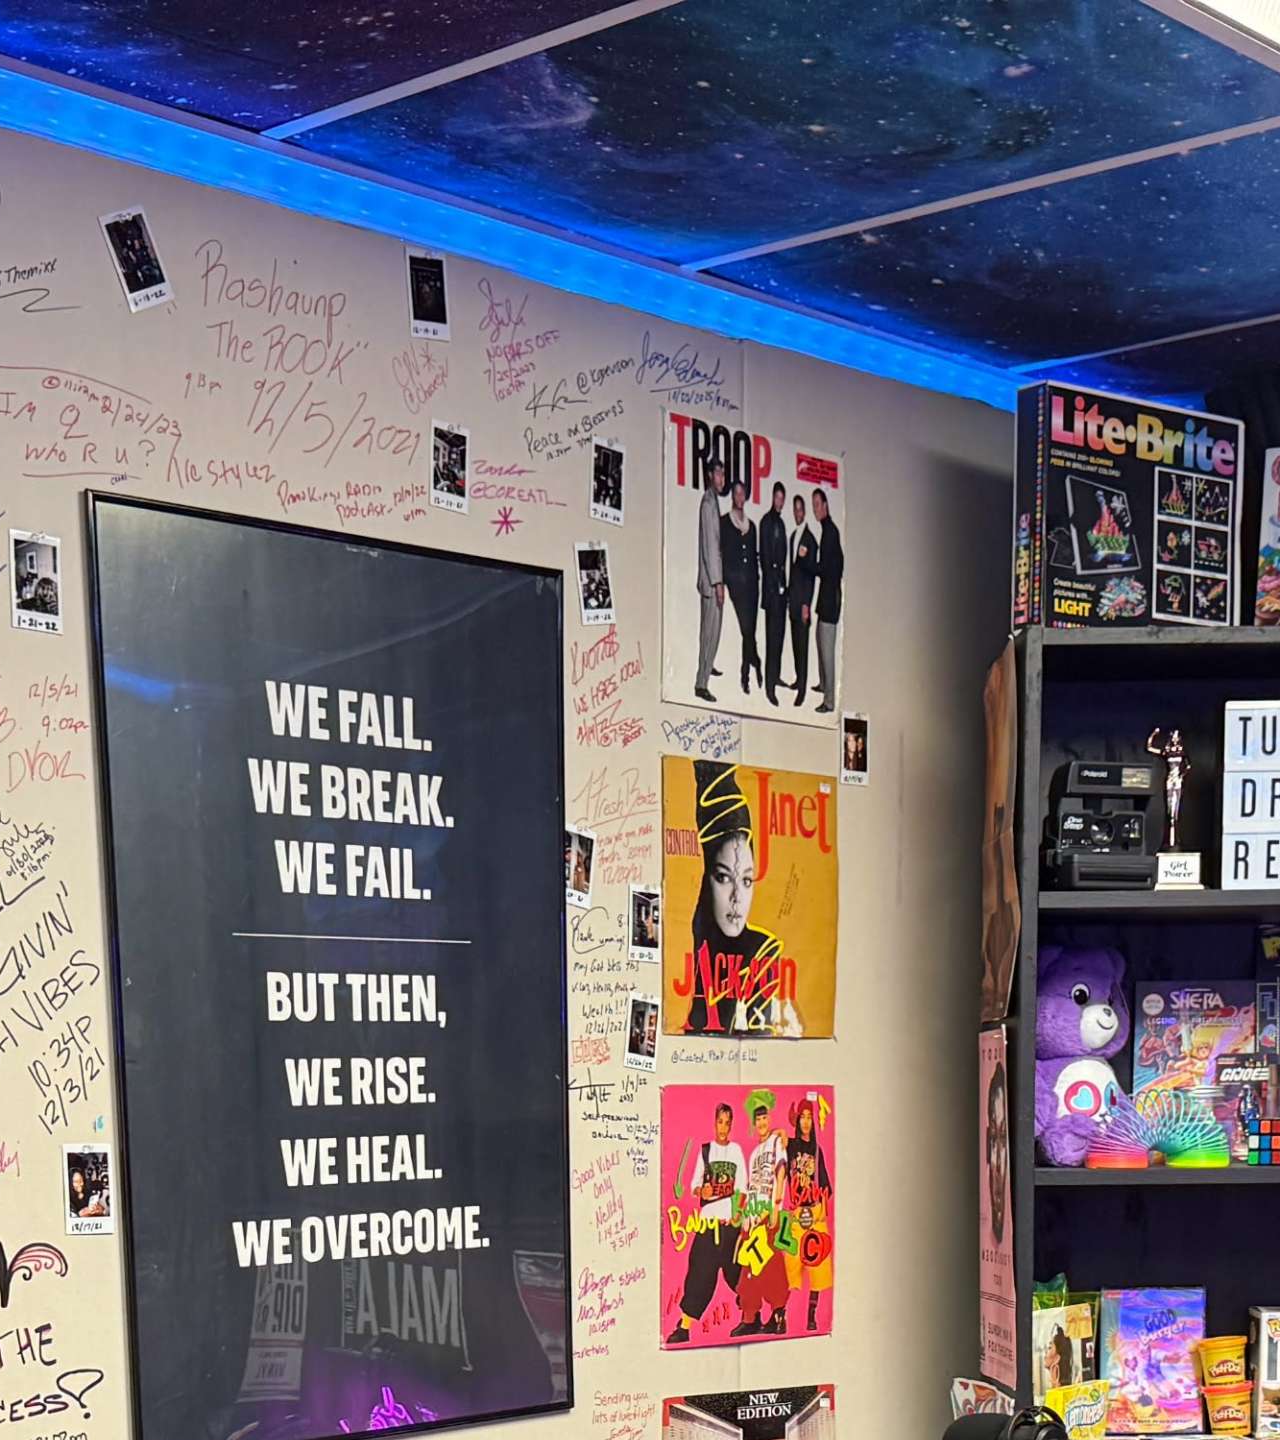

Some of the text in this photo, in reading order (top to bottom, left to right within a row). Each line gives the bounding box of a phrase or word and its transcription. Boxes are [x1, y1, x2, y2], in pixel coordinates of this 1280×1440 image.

[669, 411, 772, 506] TROOP
[1054, 598, 1093, 617] LIGHT
[265, 680, 433, 752] WE FALL.
[247, 758, 455, 829] WE BREAK.
[274, 839, 432, 901] WE FAIL.
[665, 827, 701, 859] CONTROL
[11, 949, 101, 1031] VIBES
[266, 971, 447, 1029] BUT THEN,
[284, 1055, 437, 1108] WE RISE.
[280, 1133, 443, 1187] WE HEAL.
[231, 1204, 491, 1269] WE OVERCOME.
[668, 1206, 720, 1252] Baby
[737, 1404, 792, 1421] EDITION
[749, 1392, 779, 1408] NEW
